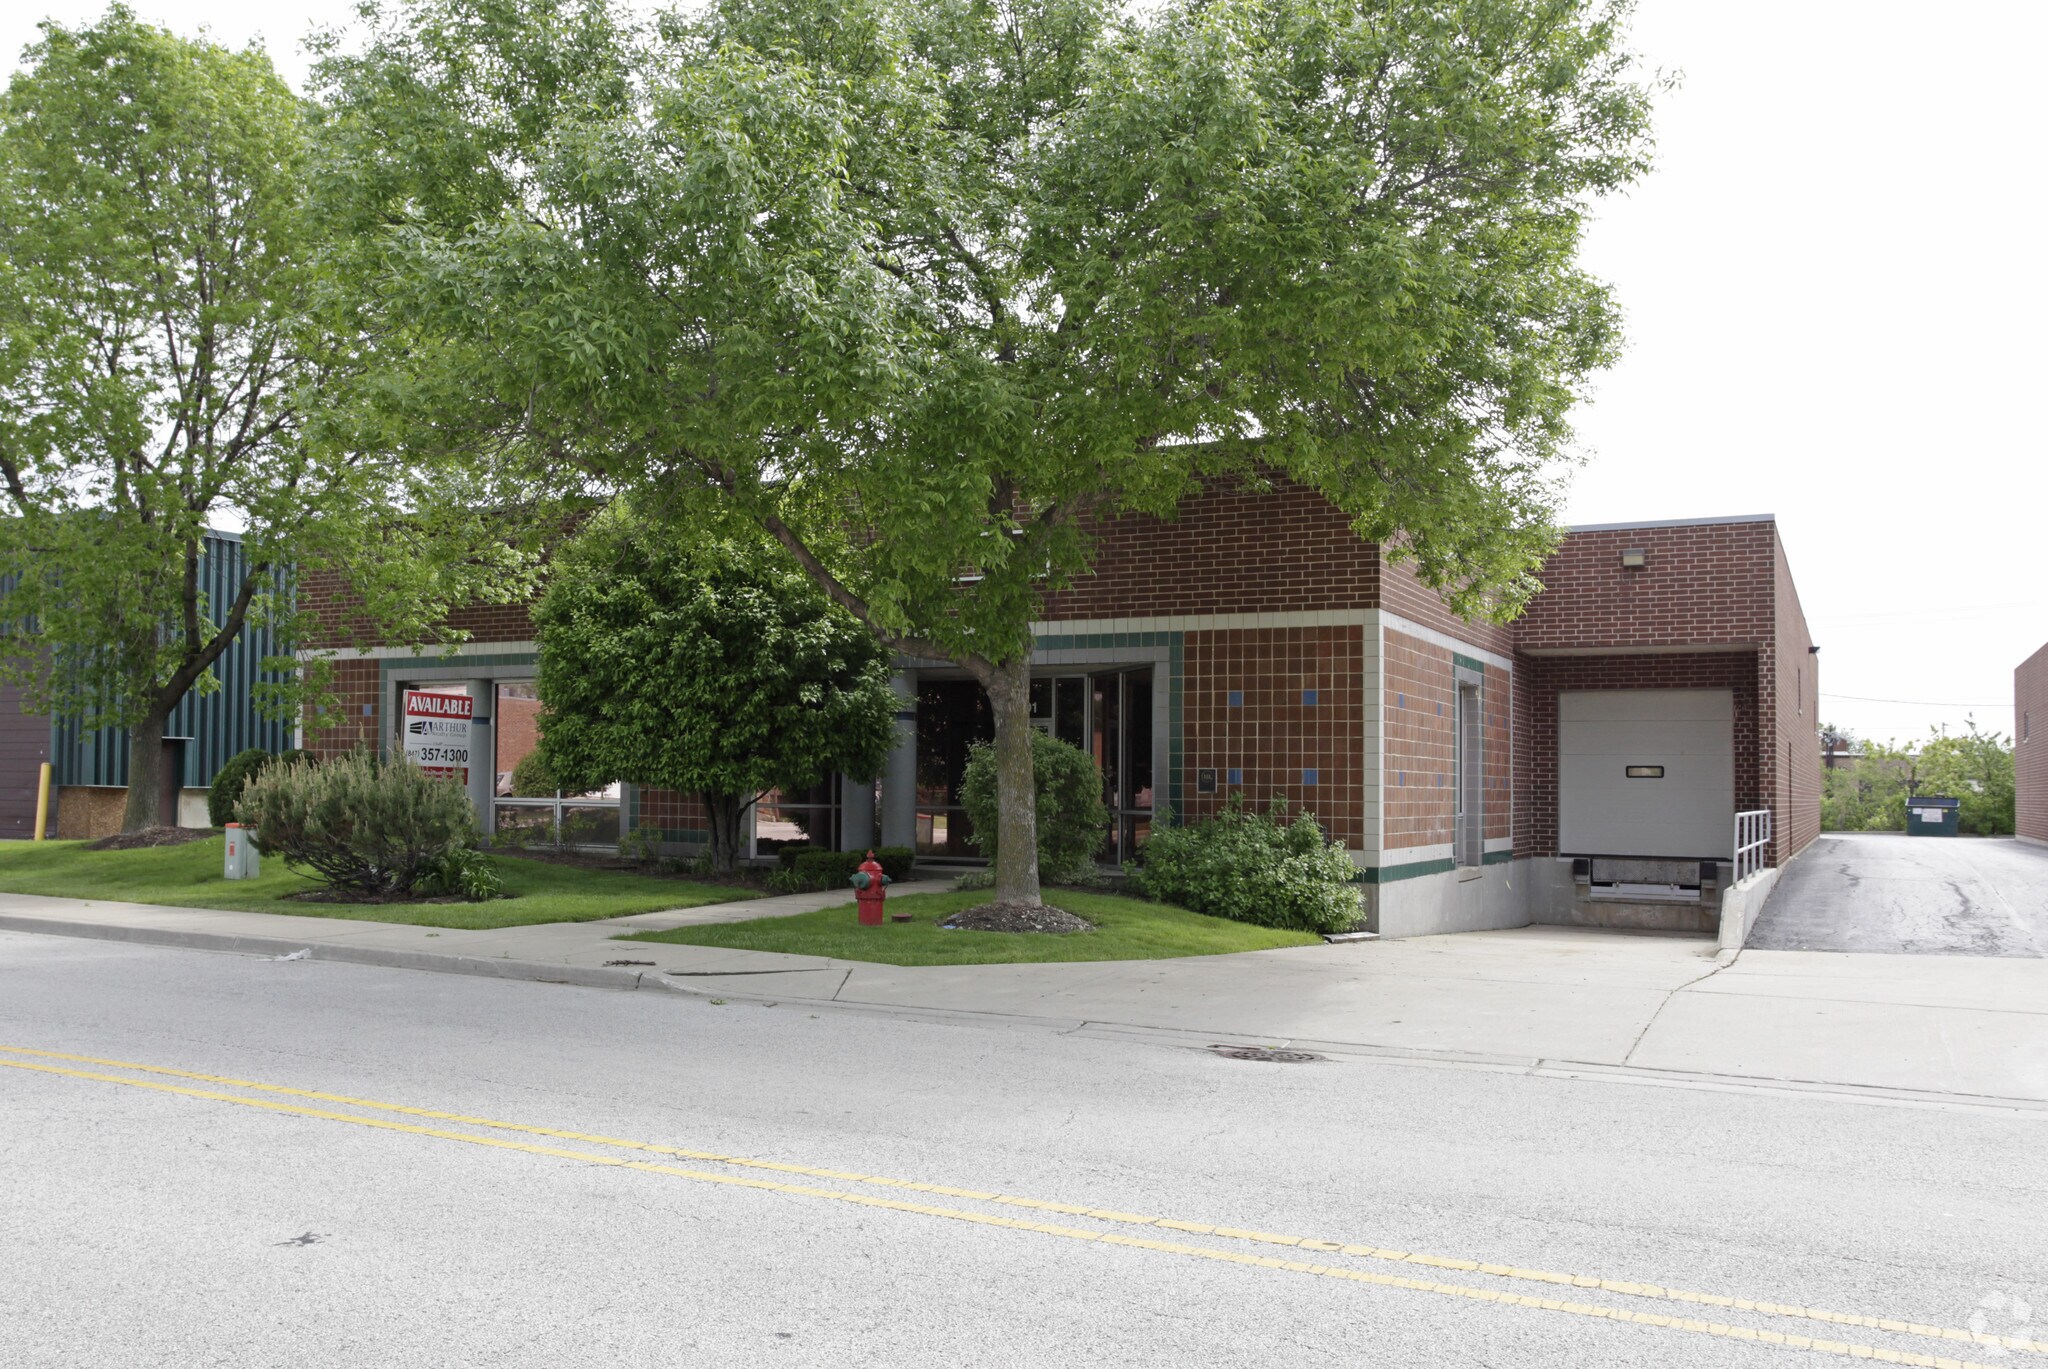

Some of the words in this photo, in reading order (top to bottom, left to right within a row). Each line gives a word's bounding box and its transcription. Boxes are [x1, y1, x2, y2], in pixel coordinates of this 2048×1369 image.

[409, 696, 471, 715] AVAILABLE
[433, 721, 467, 733] ARTHUR
[421, 748, 469, 762] 357-1300
